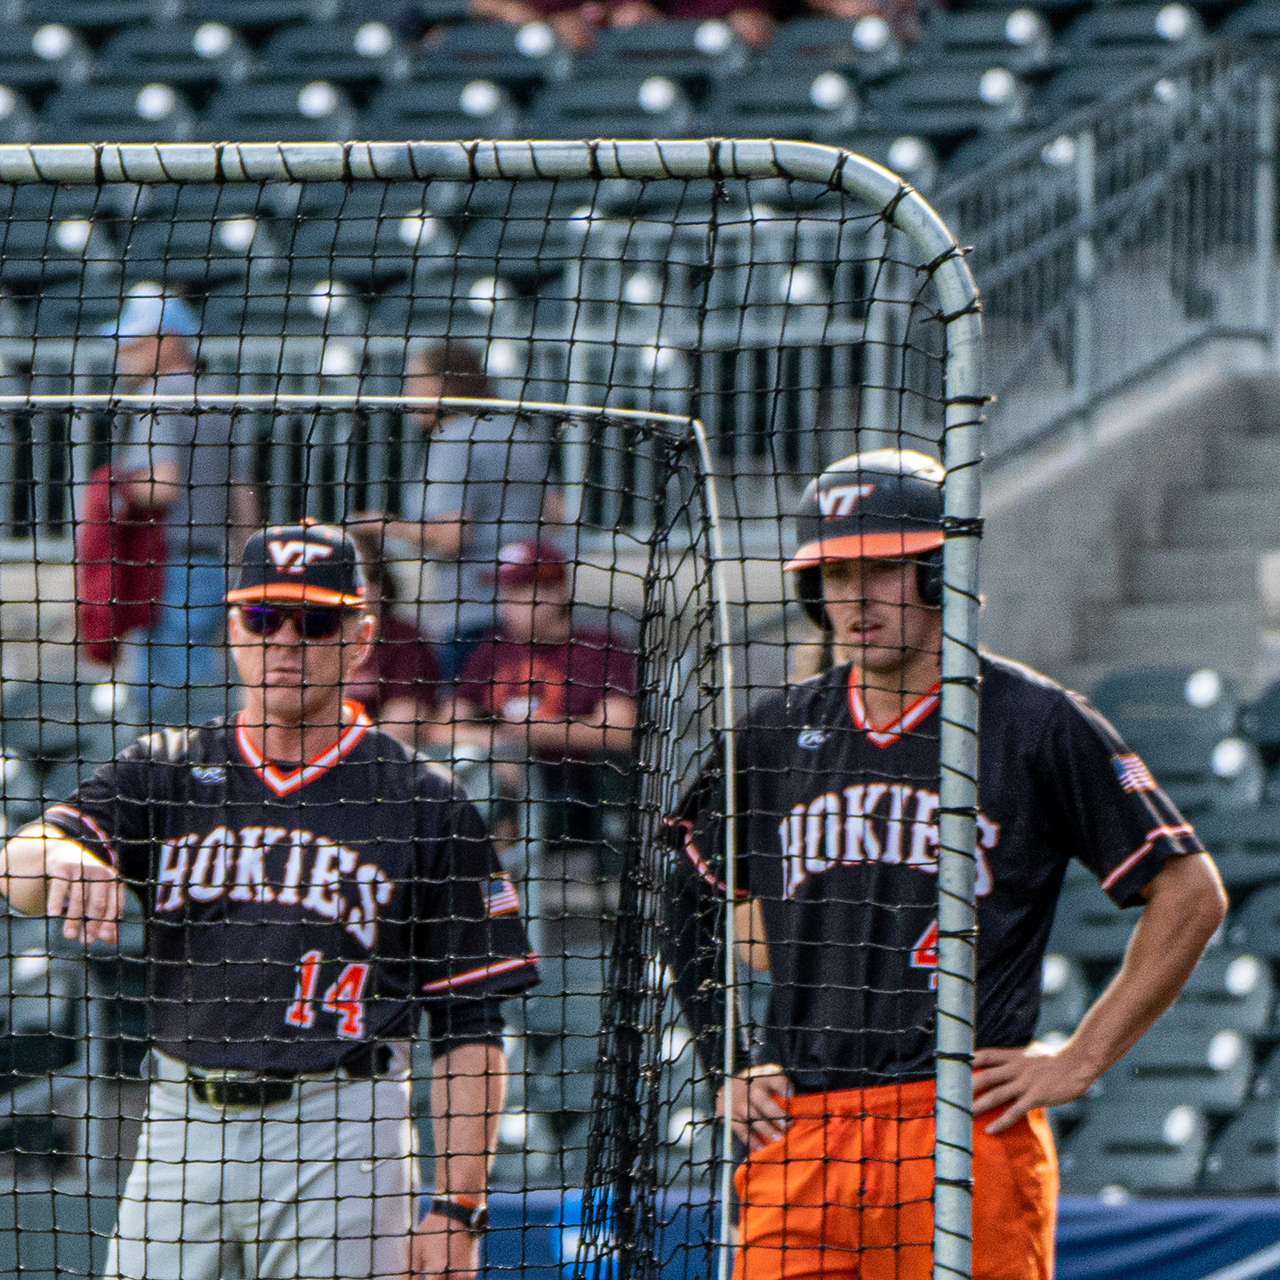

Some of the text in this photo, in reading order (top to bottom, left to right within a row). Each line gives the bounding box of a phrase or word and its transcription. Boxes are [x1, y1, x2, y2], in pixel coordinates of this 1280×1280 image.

[816, 484, 875, 521] VT
[268, 540, 334, 574] VT
[155, 825, 394, 948] HOKIES
[285, 950, 370, 1038] 14
